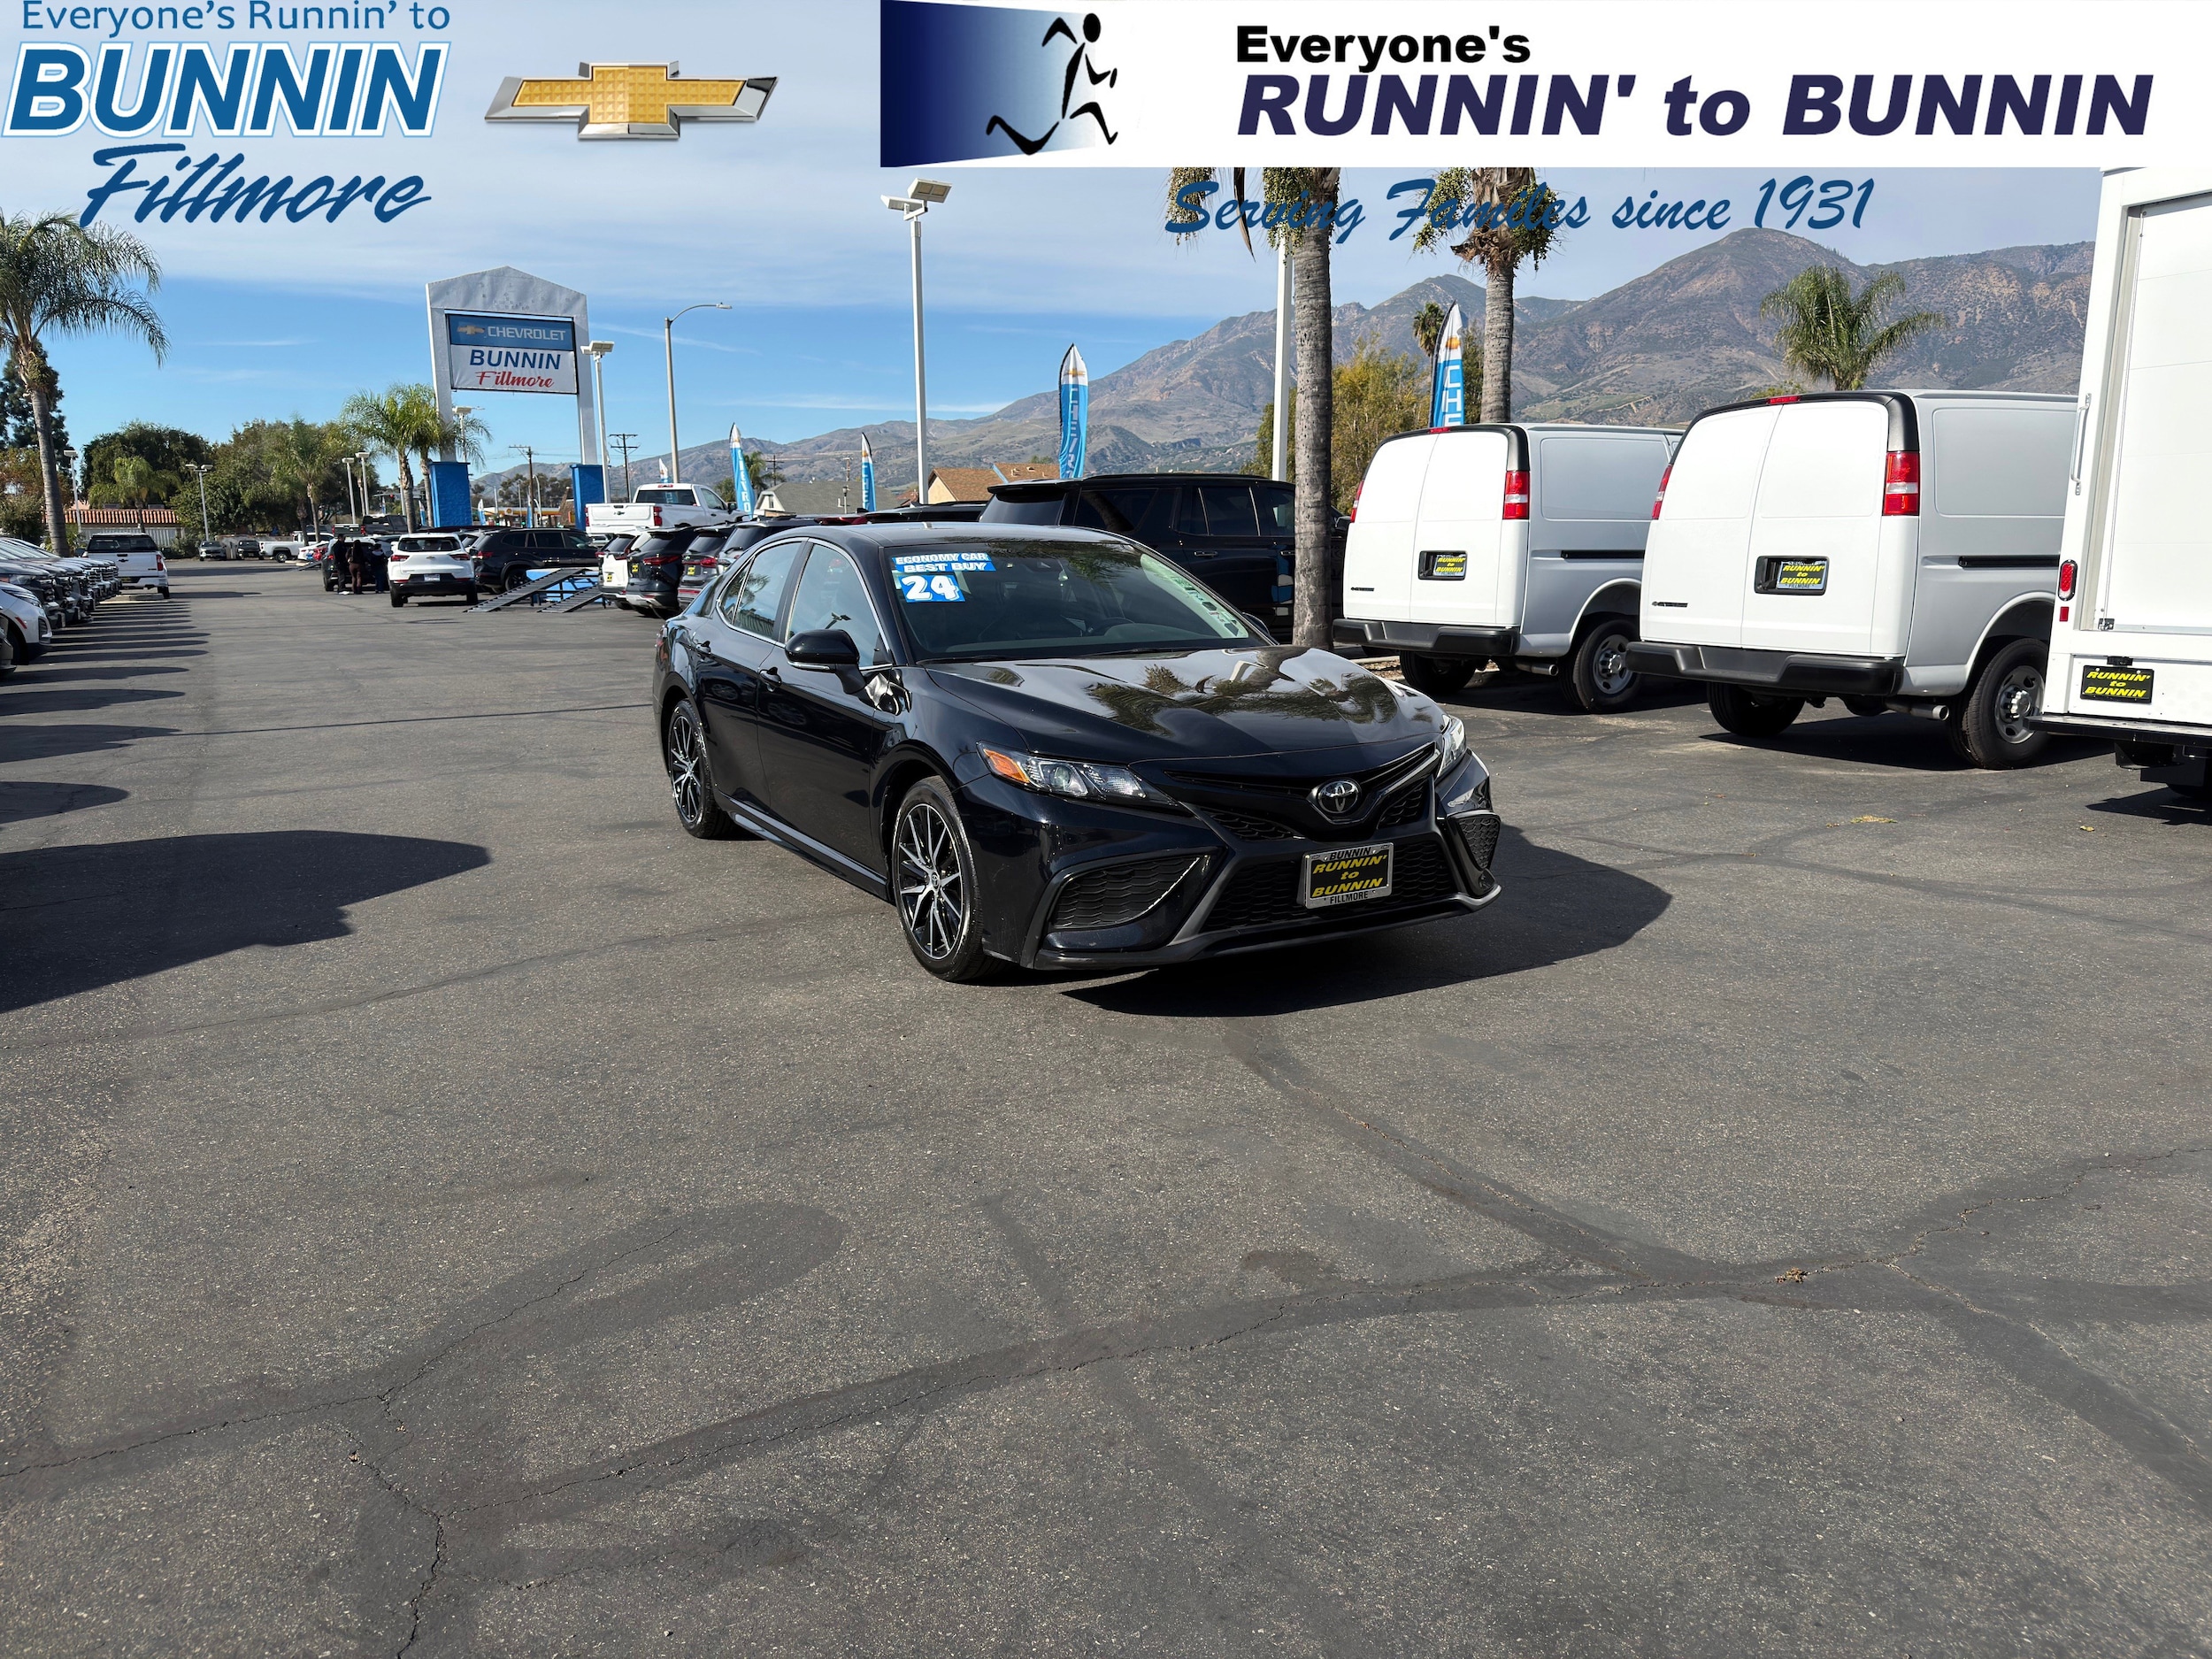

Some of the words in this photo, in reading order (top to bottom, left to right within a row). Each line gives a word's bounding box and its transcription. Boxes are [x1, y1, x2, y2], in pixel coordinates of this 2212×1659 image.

[488, 326, 566, 341] CHEVROLET
[470, 349, 561, 370] BUNNIN
[475, 371, 555, 388] Fillmore
[895, 554, 959, 565] ECONOMY
[961, 552, 989, 562] CAR
[903, 564, 949, 572] BEST
[951, 562, 987, 571] BUY
[902, 575, 959, 600] 24
[2086, 671, 2151, 682] RUNNIN'
[2085, 686, 2147, 698] BUNNIN
[1329, 847, 1371, 861] BUNNIN
[1313, 854, 1387, 874] RUNNIN'
[1340, 871, 1360, 880] to
[1311, 877, 1384, 897] BUNNIN
[1330, 890, 1369, 904] FILLMORE
